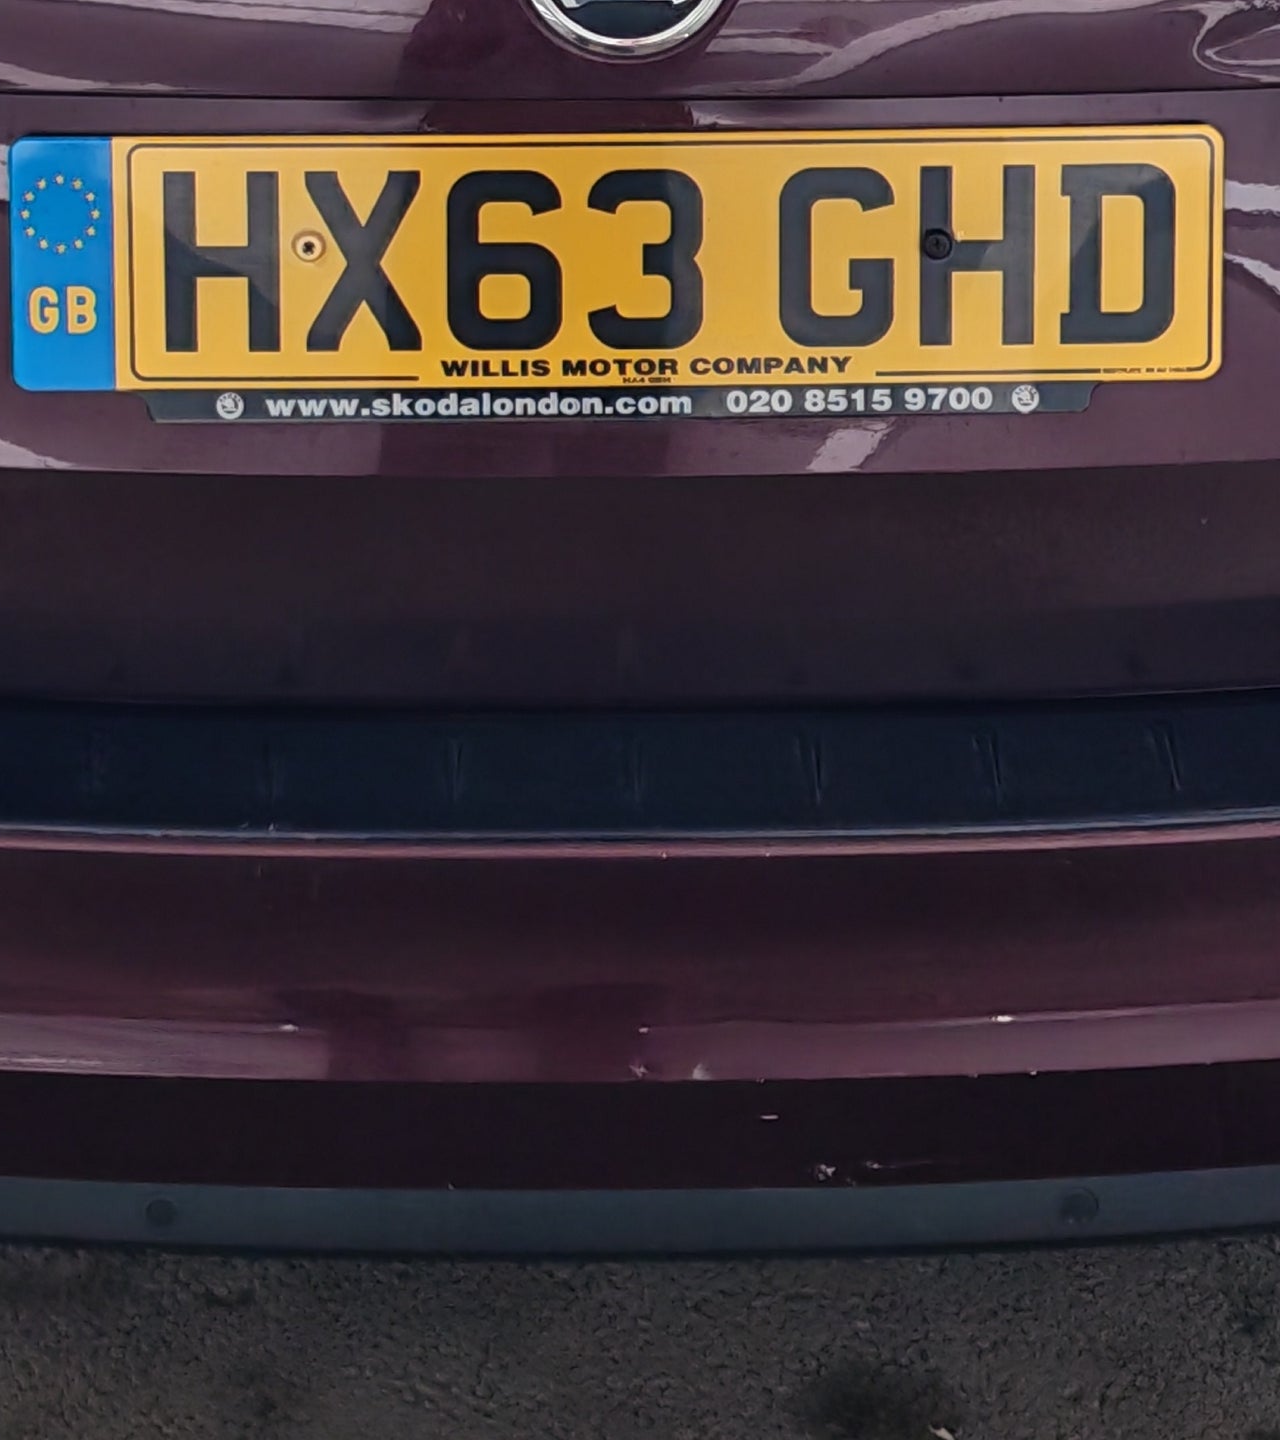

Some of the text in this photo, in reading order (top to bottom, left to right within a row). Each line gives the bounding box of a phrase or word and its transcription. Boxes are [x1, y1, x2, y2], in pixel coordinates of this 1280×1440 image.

[162, 163, 1176, 353] HX63 GHD
[29, 285, 98, 335] GB
[441, 356, 852, 377] WILLIS MOTOR COMPANY
[265, 392, 692, 418] www.skodalondon.com
[726, 387, 792, 414] 020
[804, 386, 893, 412] 8515
[904, 384, 993, 411] 9700
